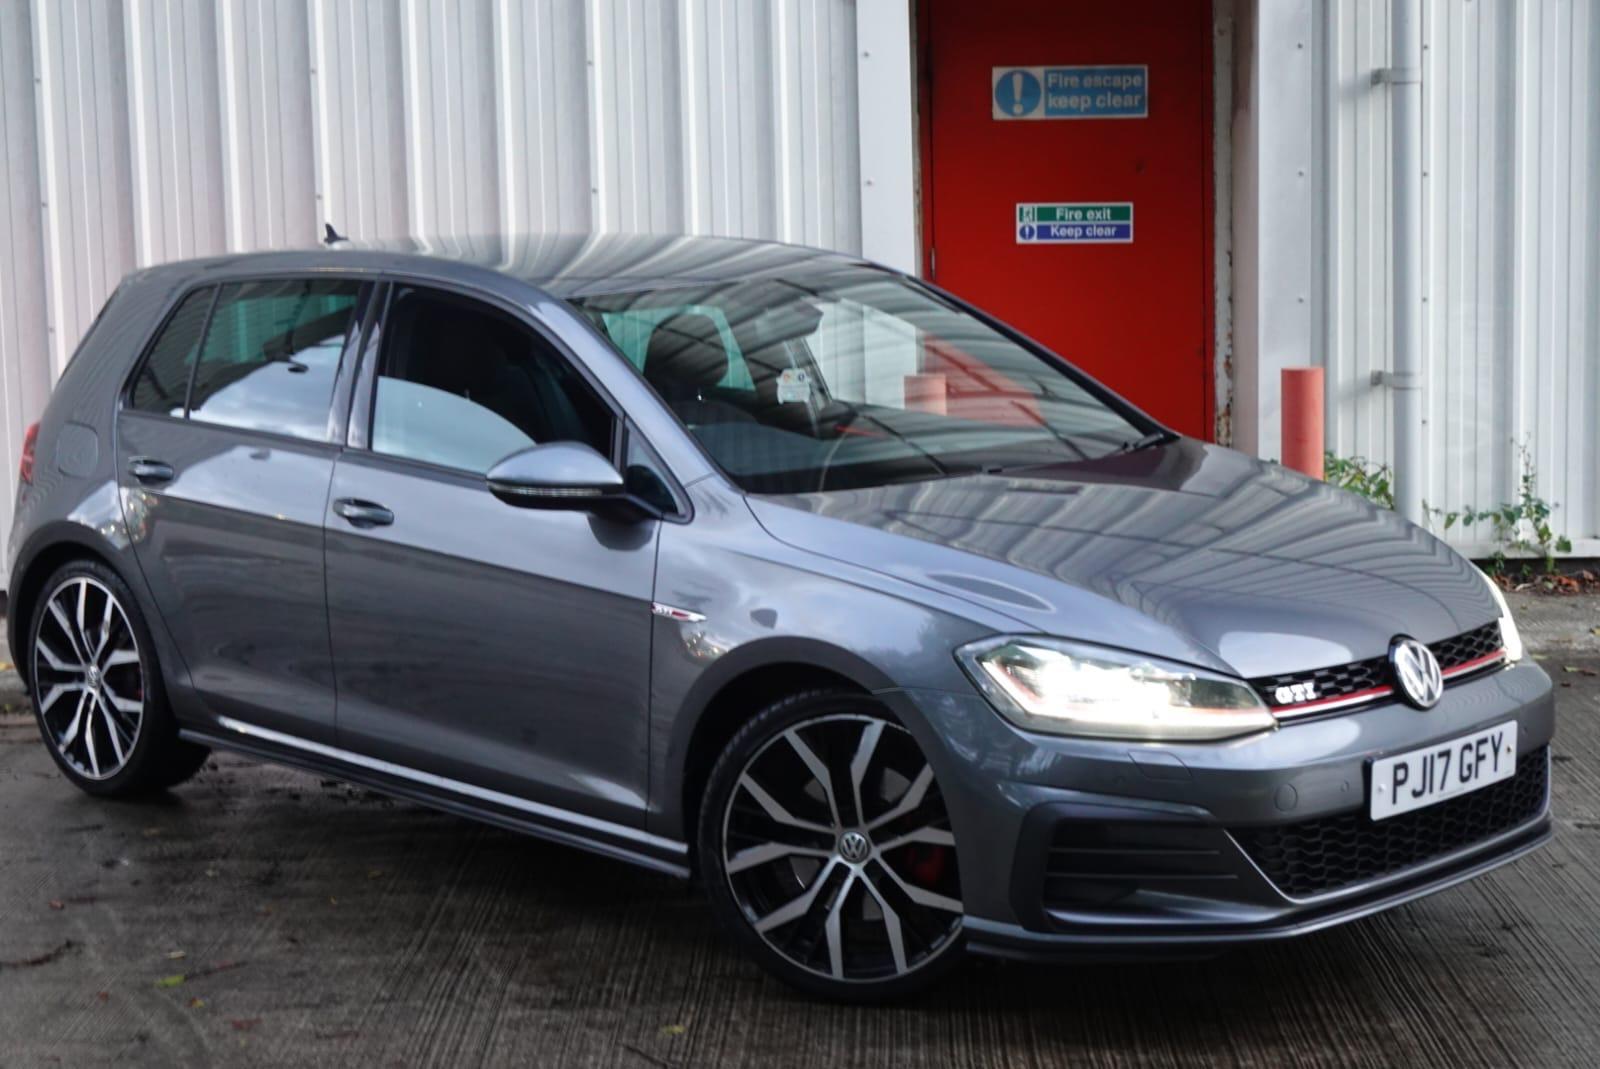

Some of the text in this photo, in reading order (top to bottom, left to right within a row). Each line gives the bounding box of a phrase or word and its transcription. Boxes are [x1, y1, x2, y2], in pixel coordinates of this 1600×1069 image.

[1048, 73, 1142, 89] Fire escape
[1048, 92, 1142, 112] keep clear
[1056, 207, 1112, 220] Fire exit
[1050, 225, 1117, 240] Keep clear
[1275, 680, 1318, 704] GTI
[1392, 731, 1503, 805] PJ17 GFY
